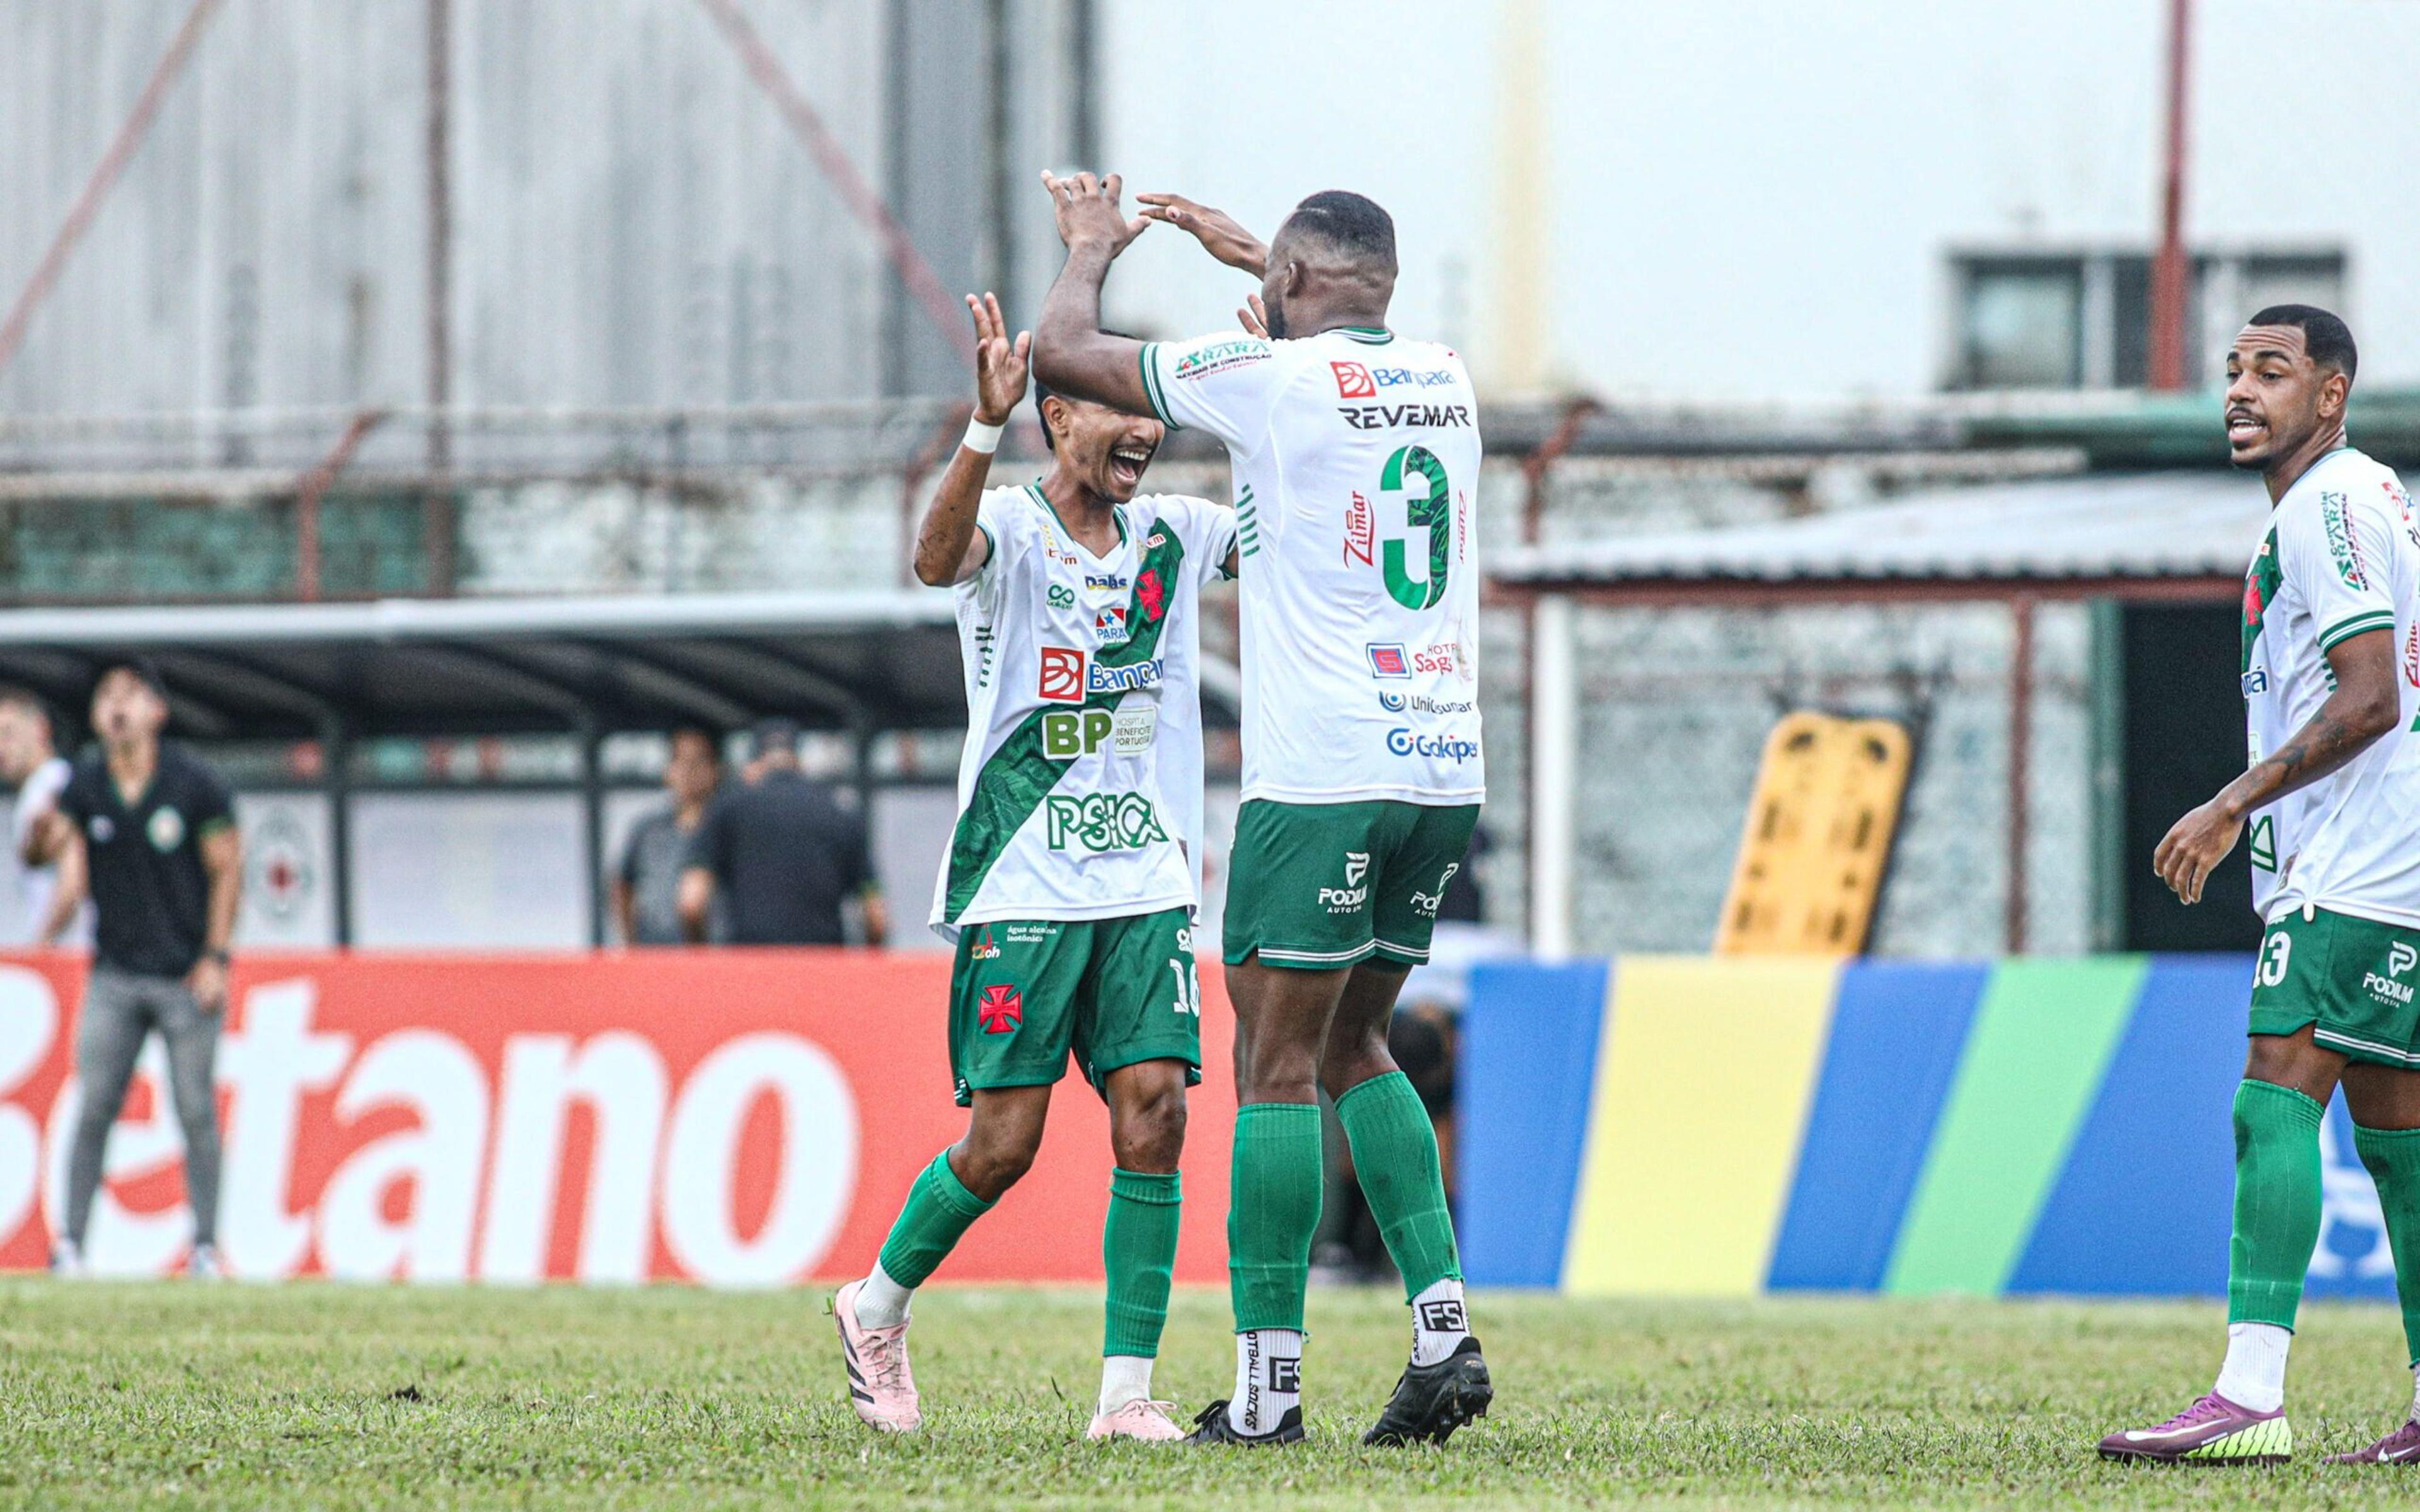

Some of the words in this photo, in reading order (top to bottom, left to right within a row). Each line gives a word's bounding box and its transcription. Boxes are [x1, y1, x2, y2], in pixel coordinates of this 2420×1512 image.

[1337, 404, 1471, 430] REVEMAR
[1343, 490, 1375, 570] Zilmar
[1380, 445, 1449, 610] 3
[1045, 711, 1113, 755] BP
[1007, 925, 1027, 935] água
[2362, 971, 2414, 1004] PODIUM
[2370, 992, 2389, 1004] AUTO
[1423, 1302, 1464, 1330] FS
[1245, 1382, 1260, 1431] SOCKS
